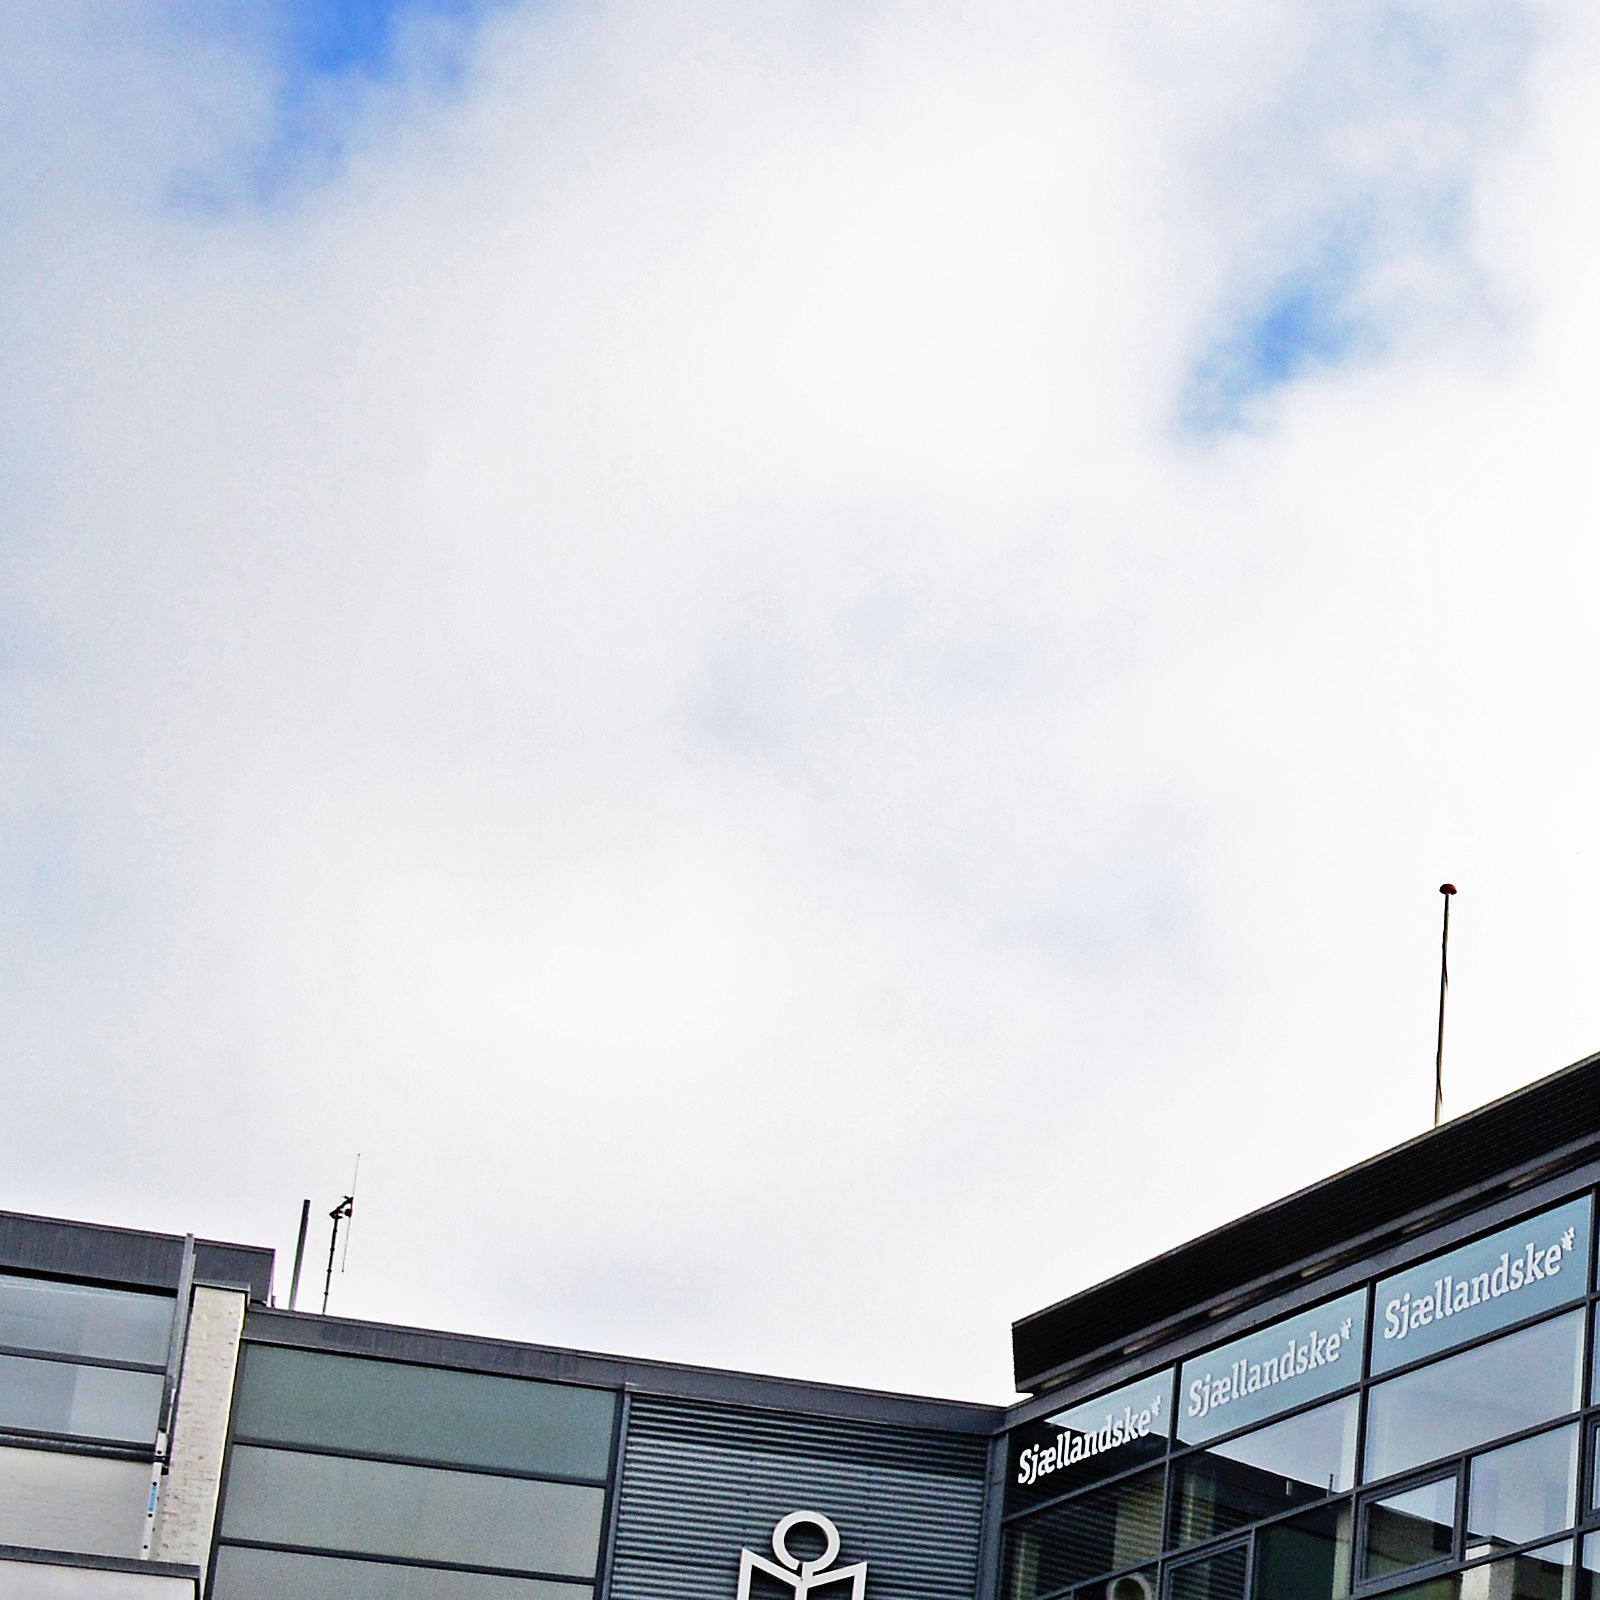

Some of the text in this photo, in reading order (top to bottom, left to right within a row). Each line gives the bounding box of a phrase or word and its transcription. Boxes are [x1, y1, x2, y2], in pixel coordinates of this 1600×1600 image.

[1383, 1243, 1563, 1341] Sjællandske
[1187, 1330, 1342, 1418] Sjællandske
[1016, 1408, 1152, 1485] Sjællandske
